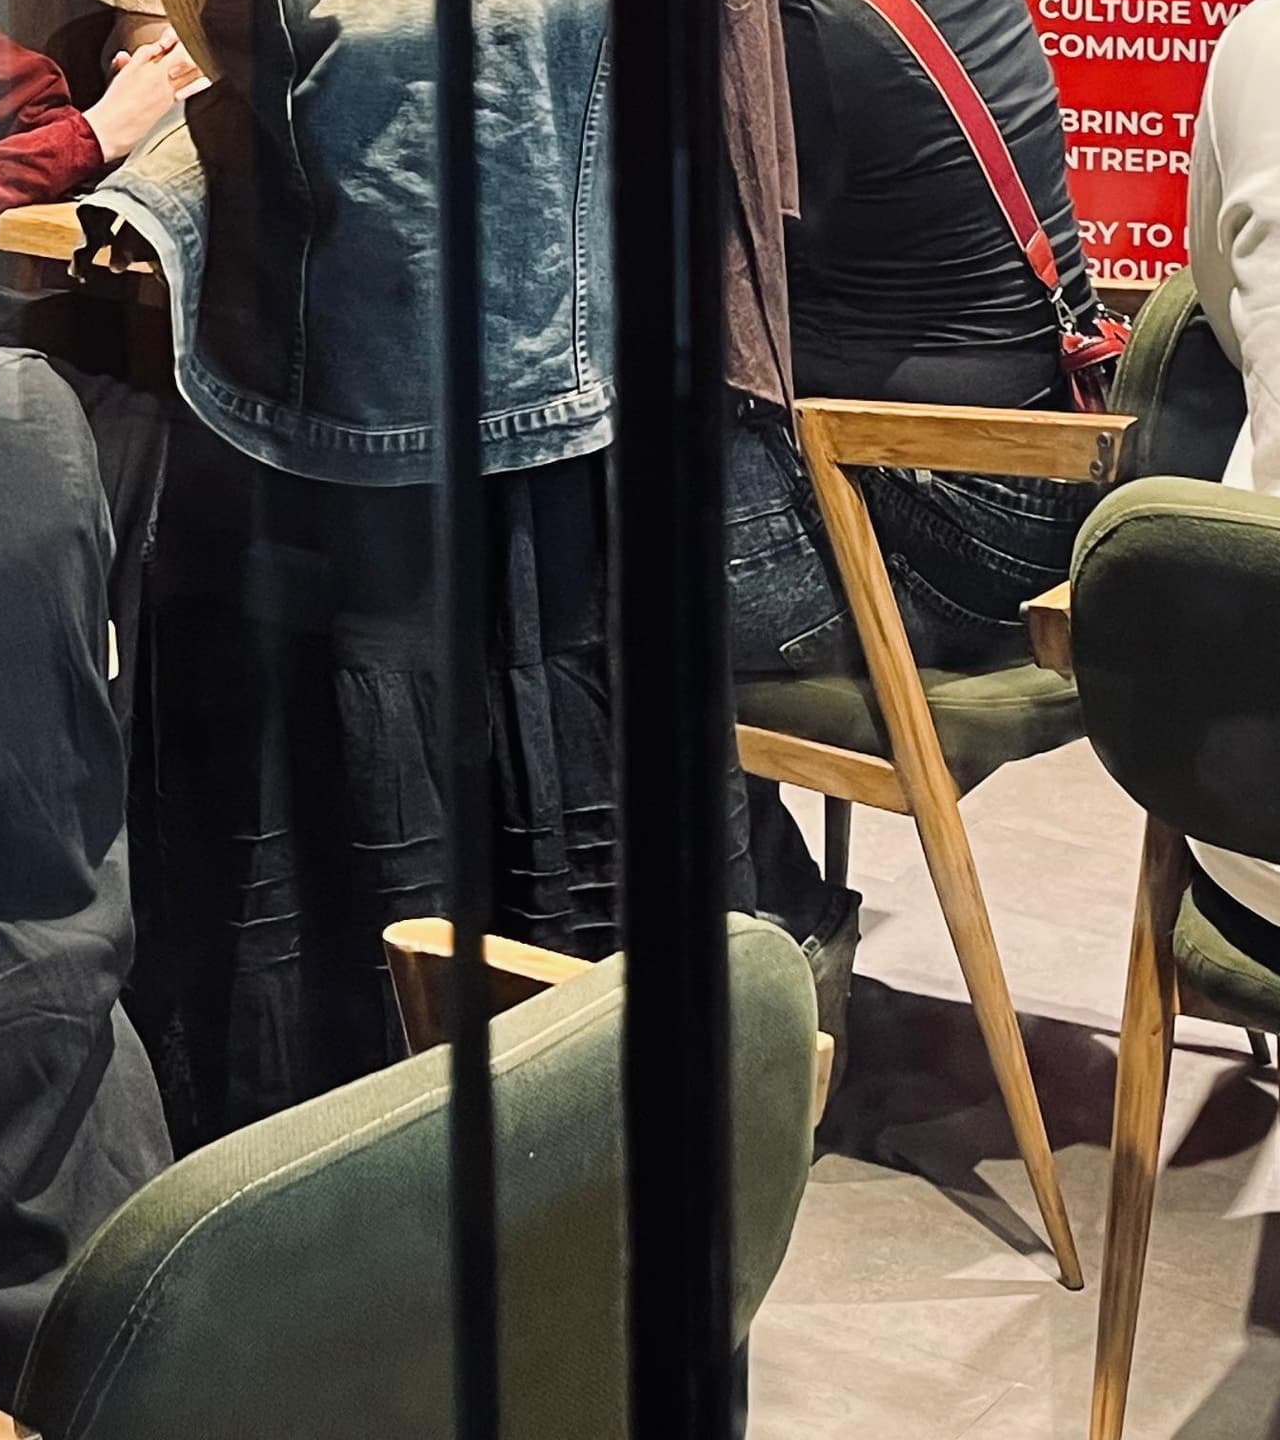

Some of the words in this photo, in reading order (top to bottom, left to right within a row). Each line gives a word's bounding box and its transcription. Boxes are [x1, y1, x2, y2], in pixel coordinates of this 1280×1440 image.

[1201, 1, 1248, 26] W
[1059, 108, 1163, 136] BRING
[1127, 222, 1173, 248] TO
